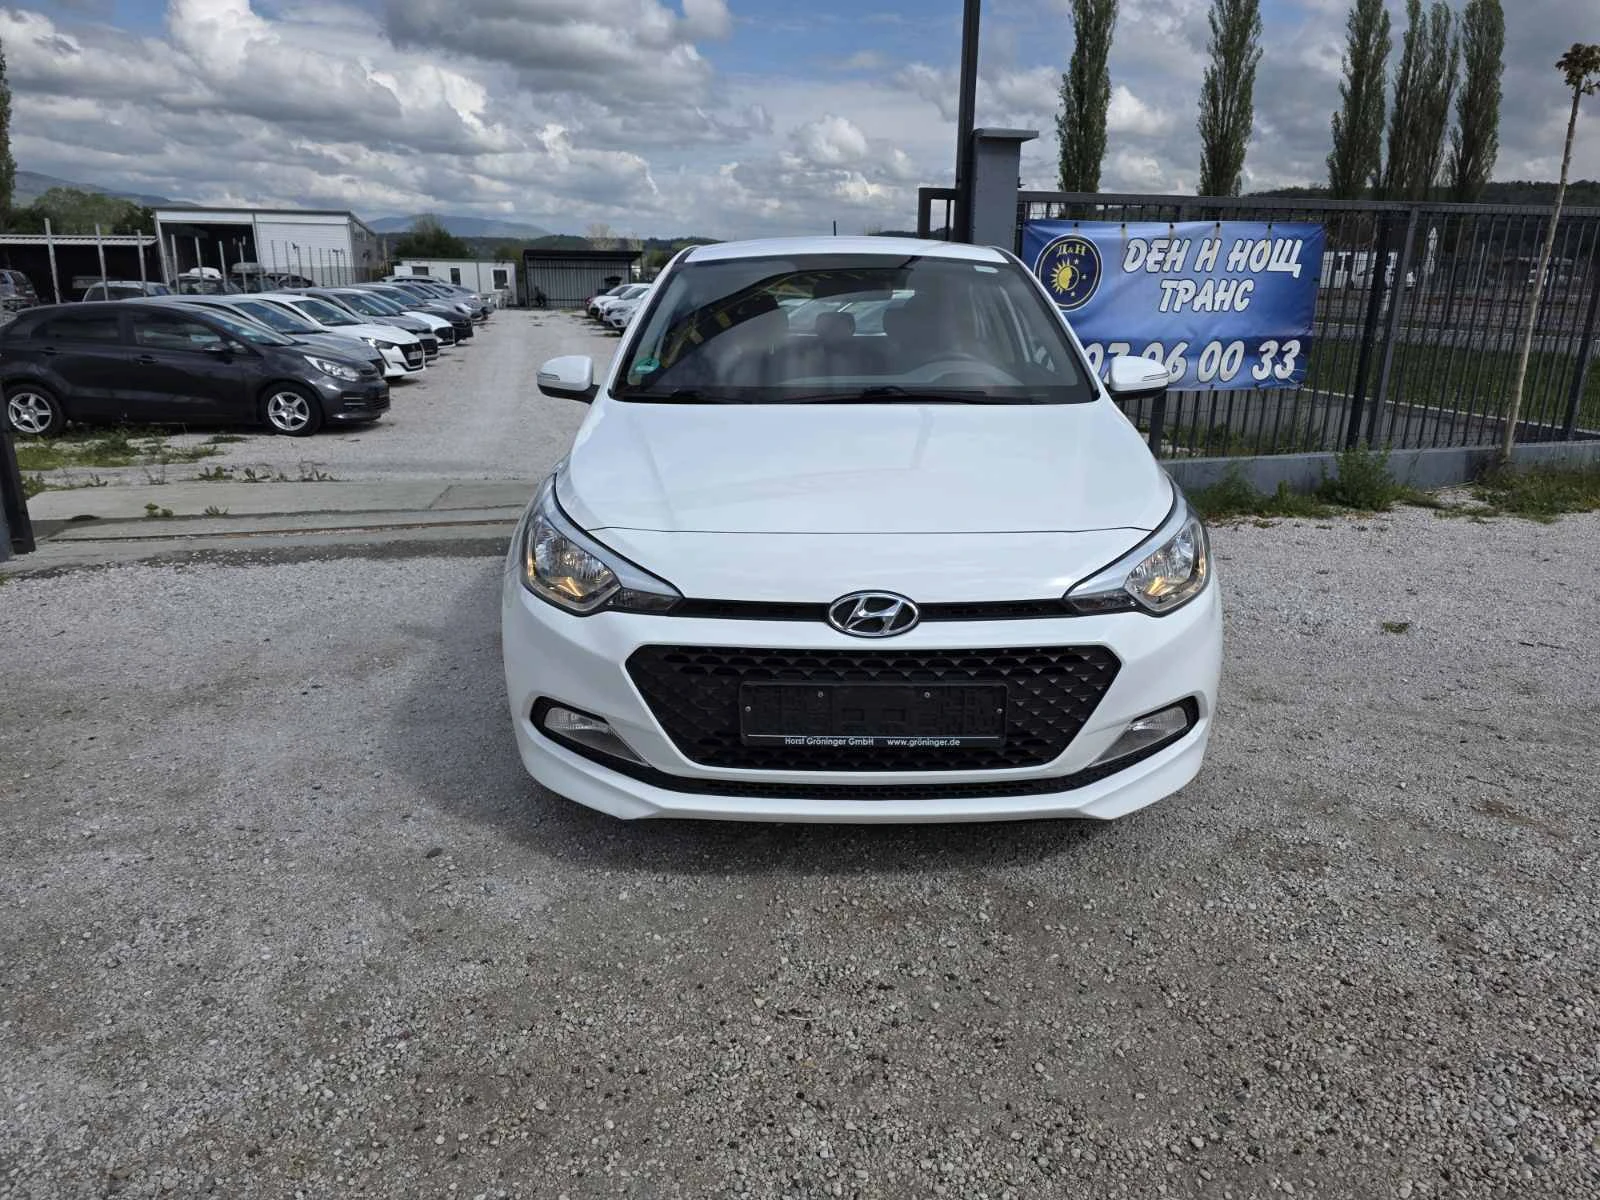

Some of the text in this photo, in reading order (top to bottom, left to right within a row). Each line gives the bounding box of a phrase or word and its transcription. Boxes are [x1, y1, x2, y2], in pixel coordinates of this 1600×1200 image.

[1226, 239, 1303, 278] НОЩ
[1159, 279, 1254, 312] ТРАНС
[1198, 340, 1245, 382] 00
[1252, 339, 1300, 380] 33
[848, 737, 874, 745] GmbH
